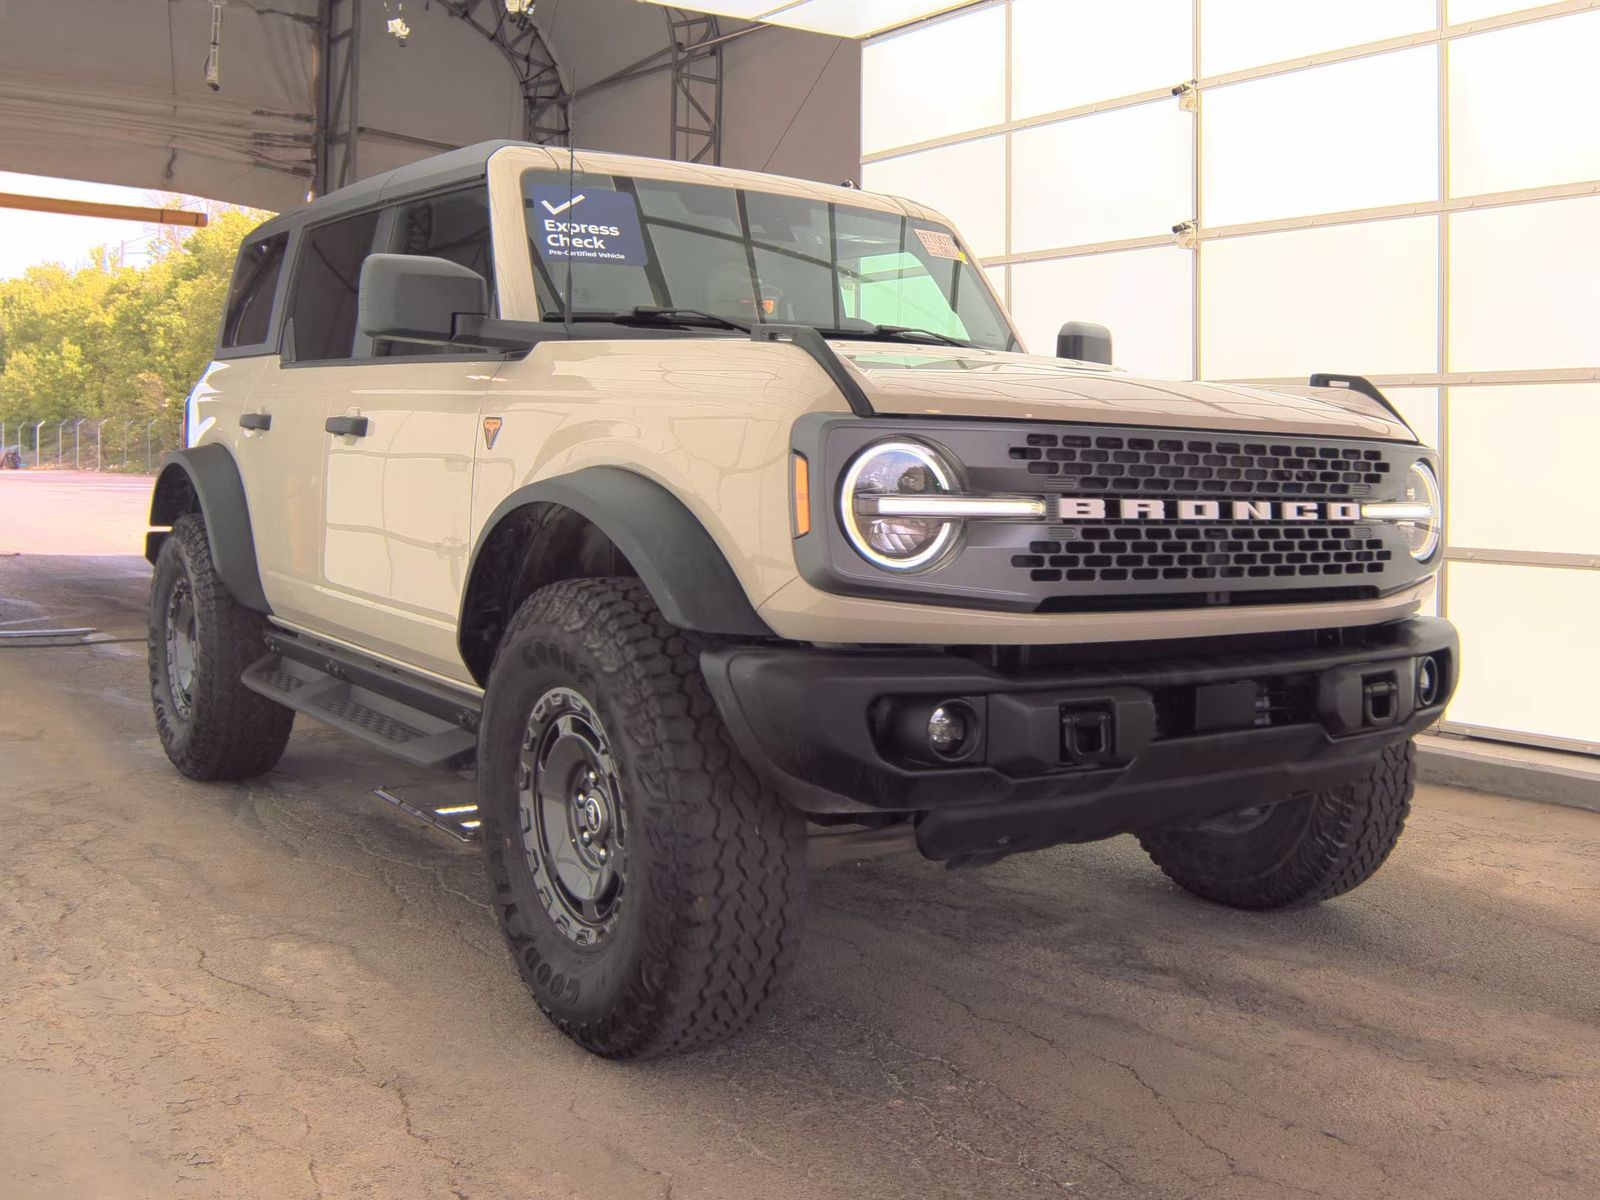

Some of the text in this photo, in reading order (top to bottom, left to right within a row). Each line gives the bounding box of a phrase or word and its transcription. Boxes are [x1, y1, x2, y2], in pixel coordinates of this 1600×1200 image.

[544, 219, 620, 236] Express
[546, 234, 606, 249] Check
[1058, 497, 1361, 520] BRONCO
